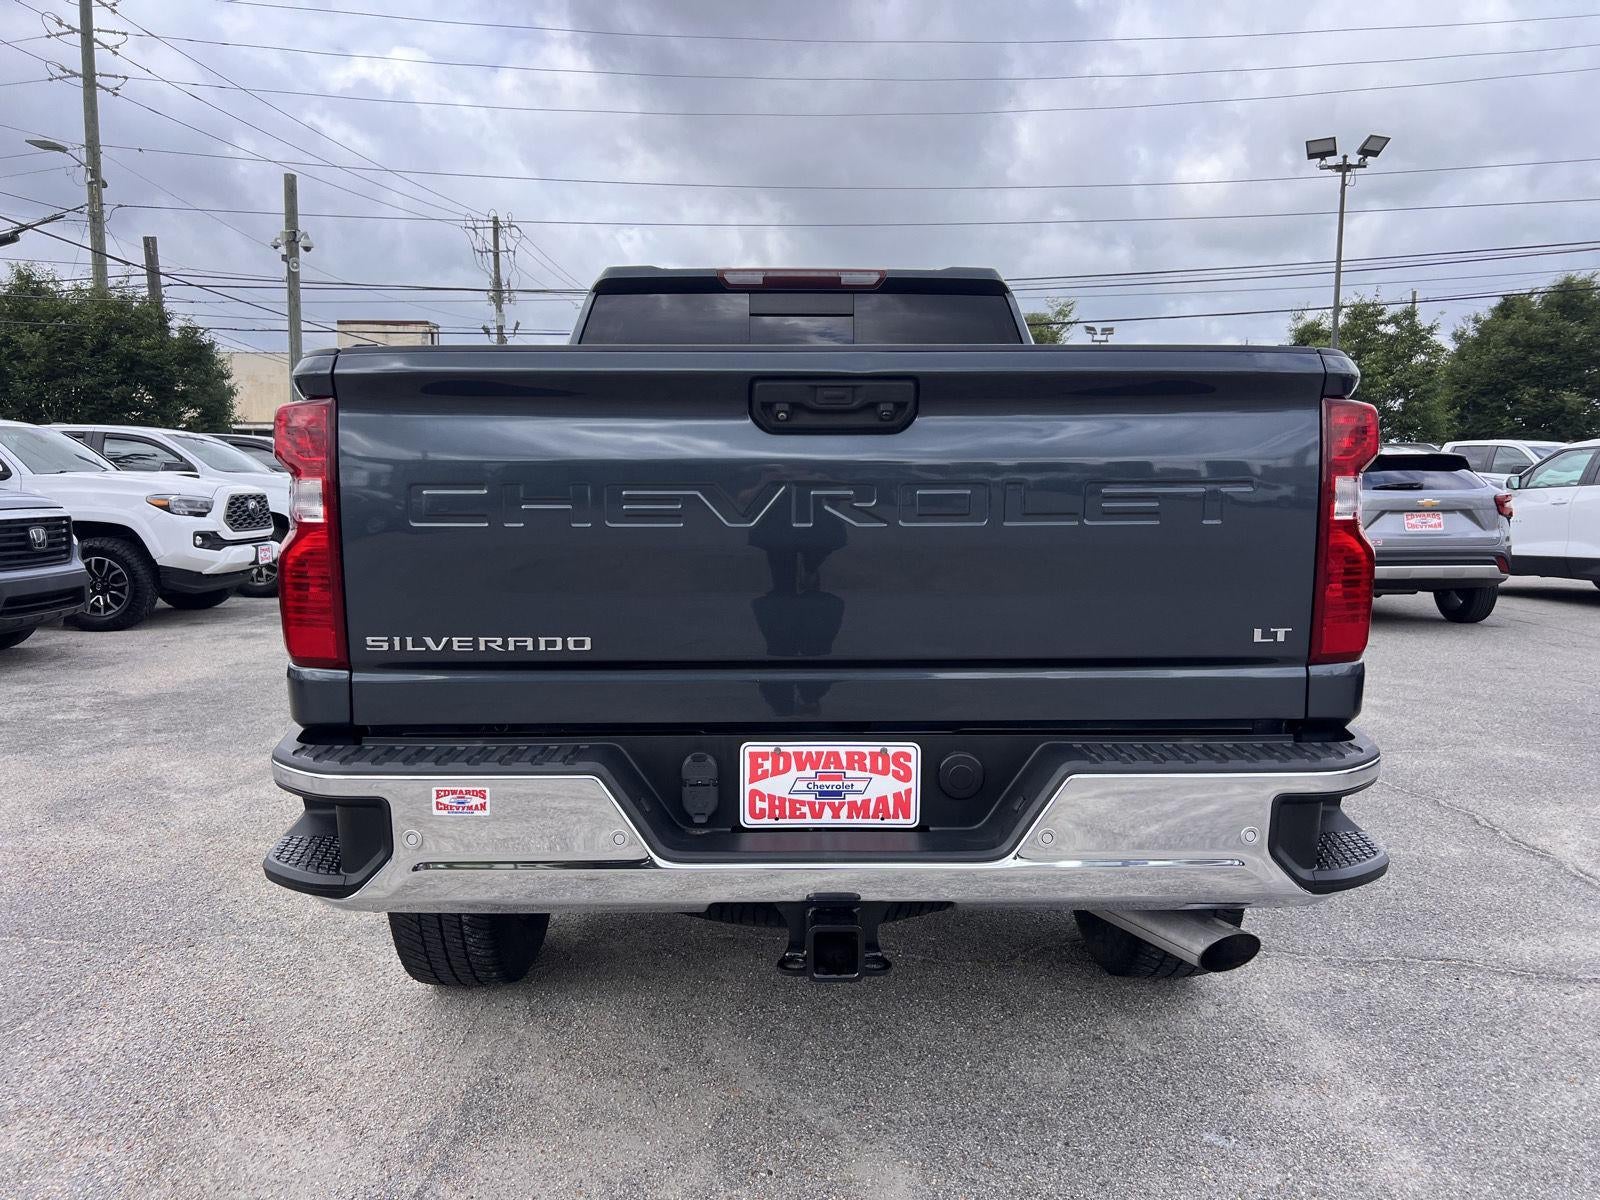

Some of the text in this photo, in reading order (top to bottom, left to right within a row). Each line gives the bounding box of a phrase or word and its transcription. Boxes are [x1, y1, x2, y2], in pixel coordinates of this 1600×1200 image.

[408, 477, 1256, 527] CHEVROLET
[1253, 628, 1293, 643] LT
[365, 636, 592, 652] SILVERADO
[748, 750, 913, 784] EDWARDS
[806, 781, 855, 790] Chevrolet
[435, 789, 487, 800] EDWARDS
[435, 800, 487, 811] CHEVYMAN
[748, 787, 913, 820] CHEVYMAN
